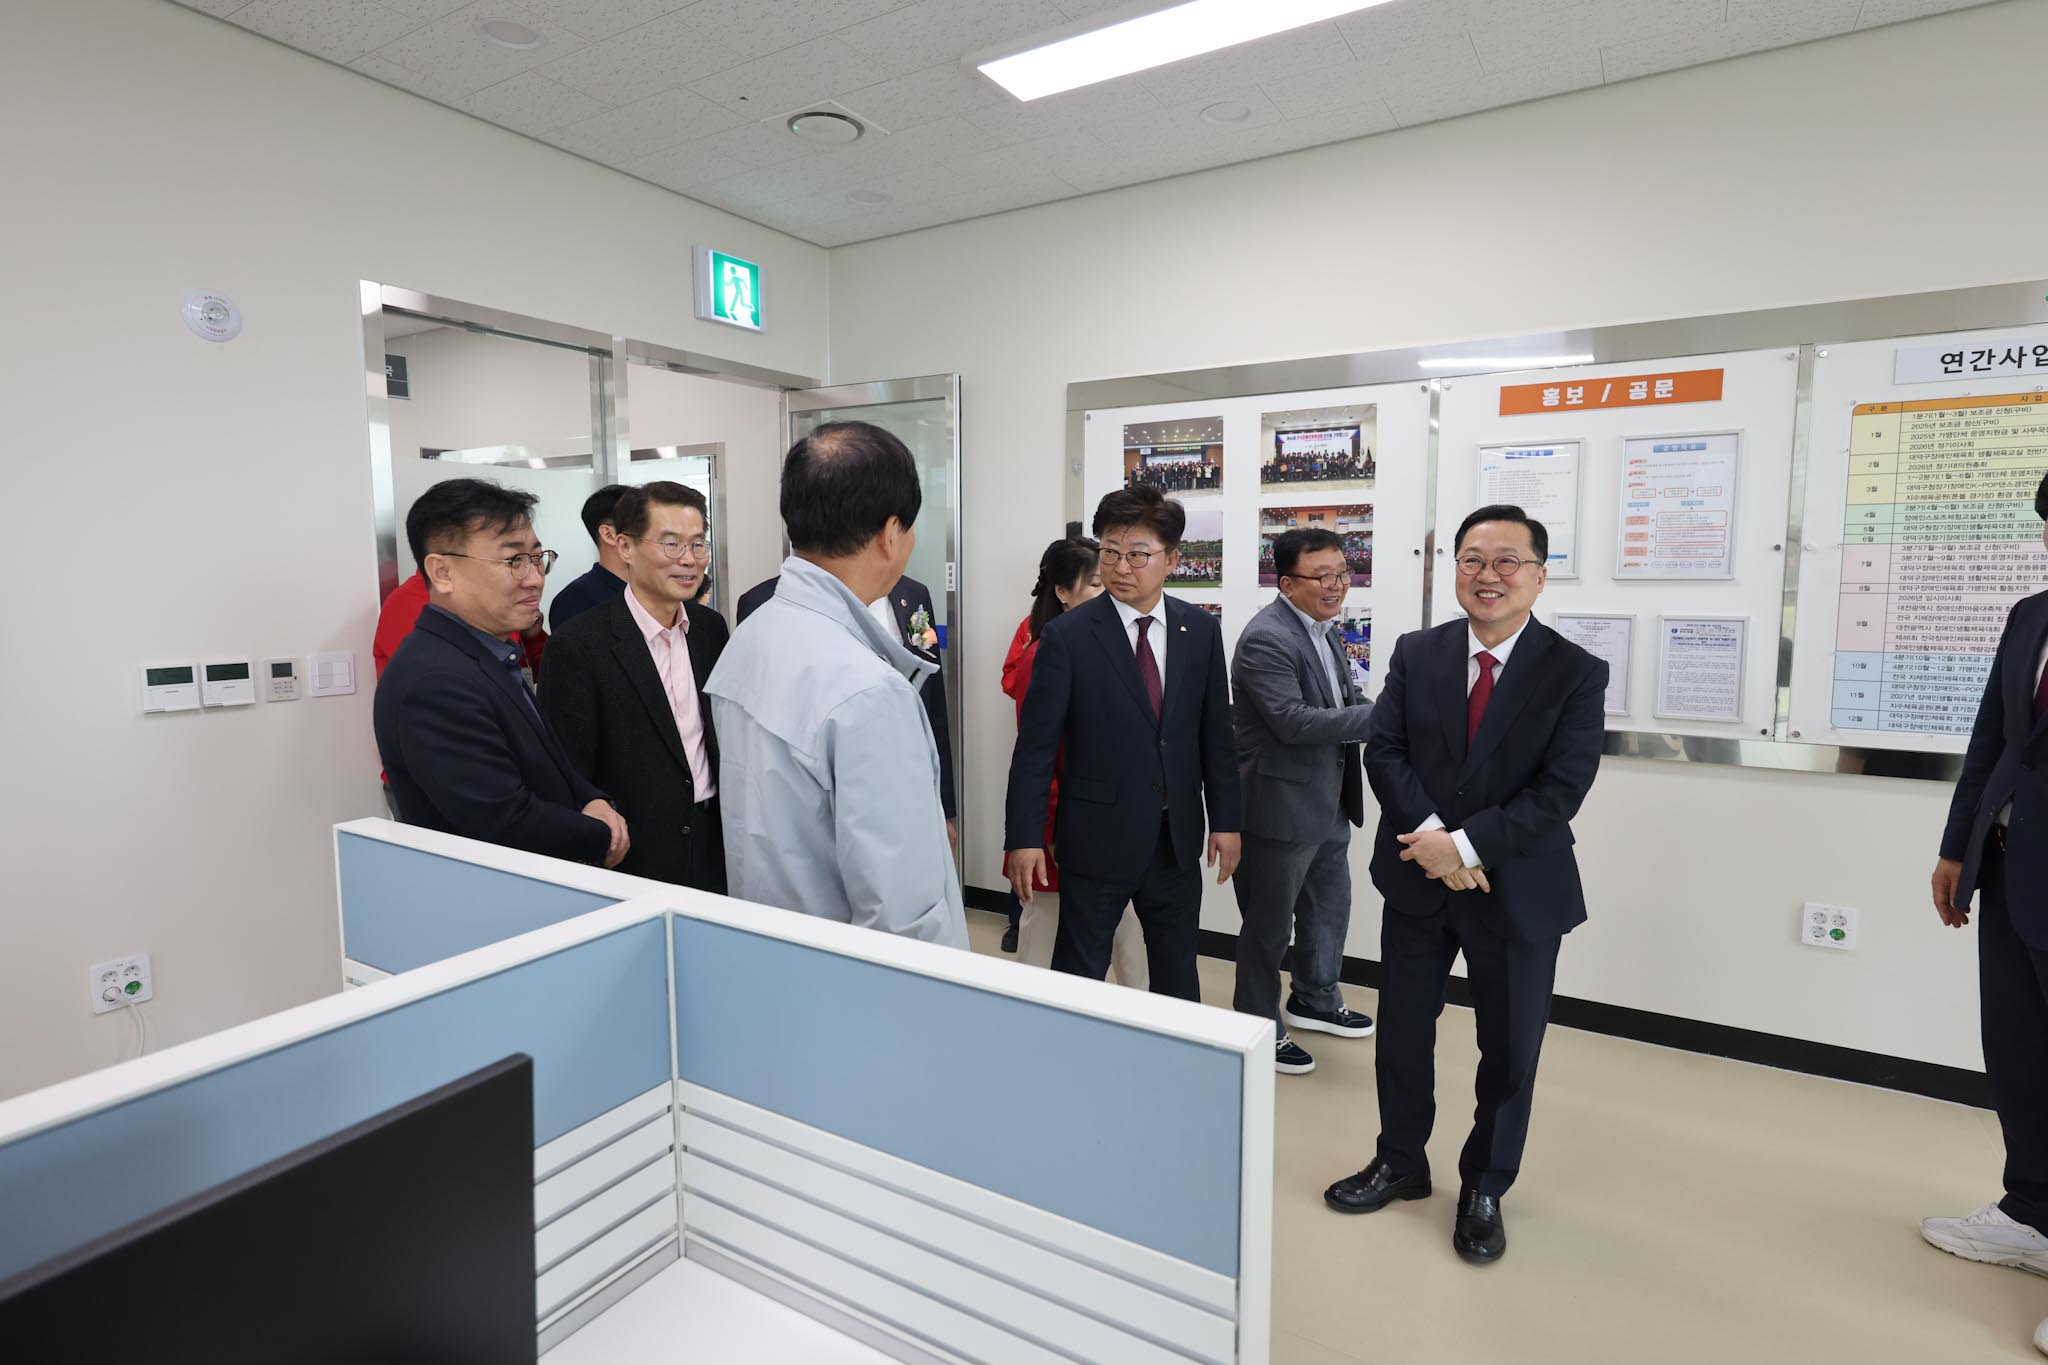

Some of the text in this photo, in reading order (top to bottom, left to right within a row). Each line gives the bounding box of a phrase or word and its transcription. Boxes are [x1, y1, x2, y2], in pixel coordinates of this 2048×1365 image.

[1940, 344, 2048, 374] 연간사업
[1542, 379, 1674, 406] 홍보 / 공문
[1996, 406, 2032, 415] 신청(구비)
[1911, 422, 1936, 430] 2025년
[1939, 420, 1961, 428] 보조금
[1910, 432, 1935, 440] 2025년
[1970, 428, 2008, 437] 운영지원금
[1909, 442, 1935, 450] 2026년
[1978, 448, 2023, 457] 생활체육교실
[1866, 485, 1877, 493] 3월
[1906, 480, 2041, 491] 대덕구청장기장애인K-POP댄스경연대
